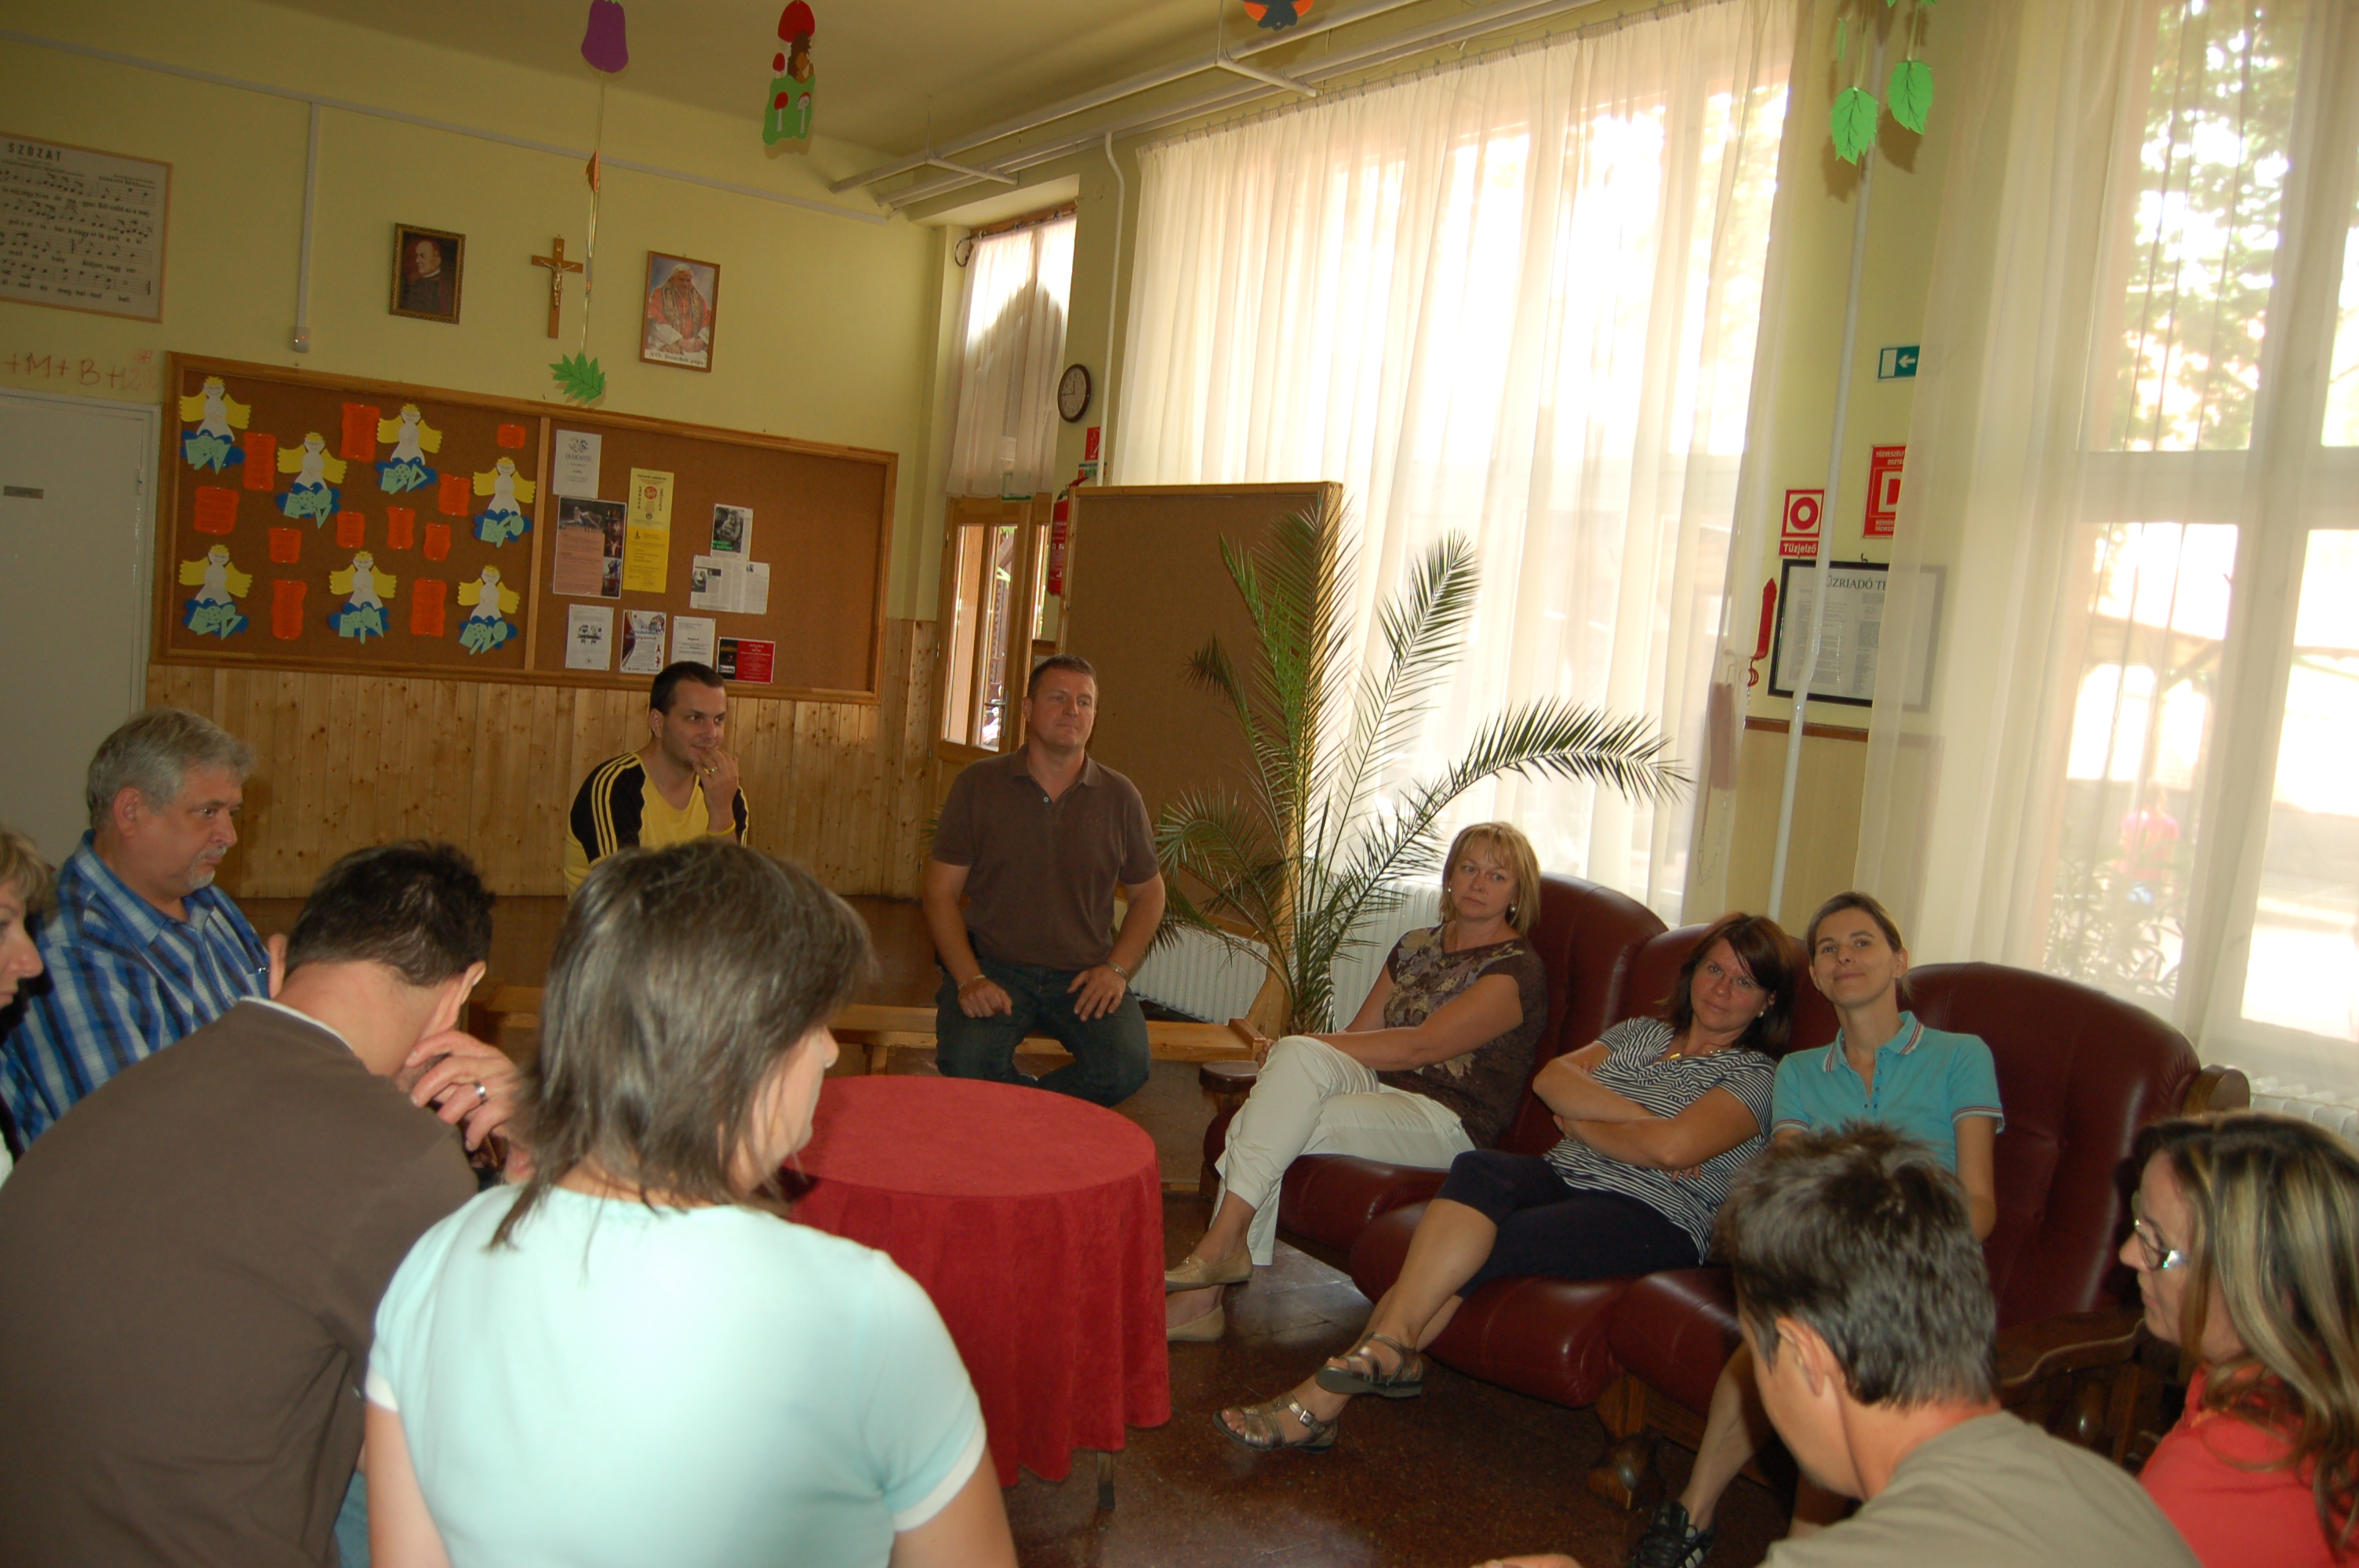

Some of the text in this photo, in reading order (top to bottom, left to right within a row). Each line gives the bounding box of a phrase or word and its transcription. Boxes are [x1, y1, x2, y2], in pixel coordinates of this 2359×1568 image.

[9, 142, 62, 162] SZÓZAT
[1783, 542, 1817, 555] Tűzjelző
[1826, 574, 1874, 590] ŰZRIADÓ
